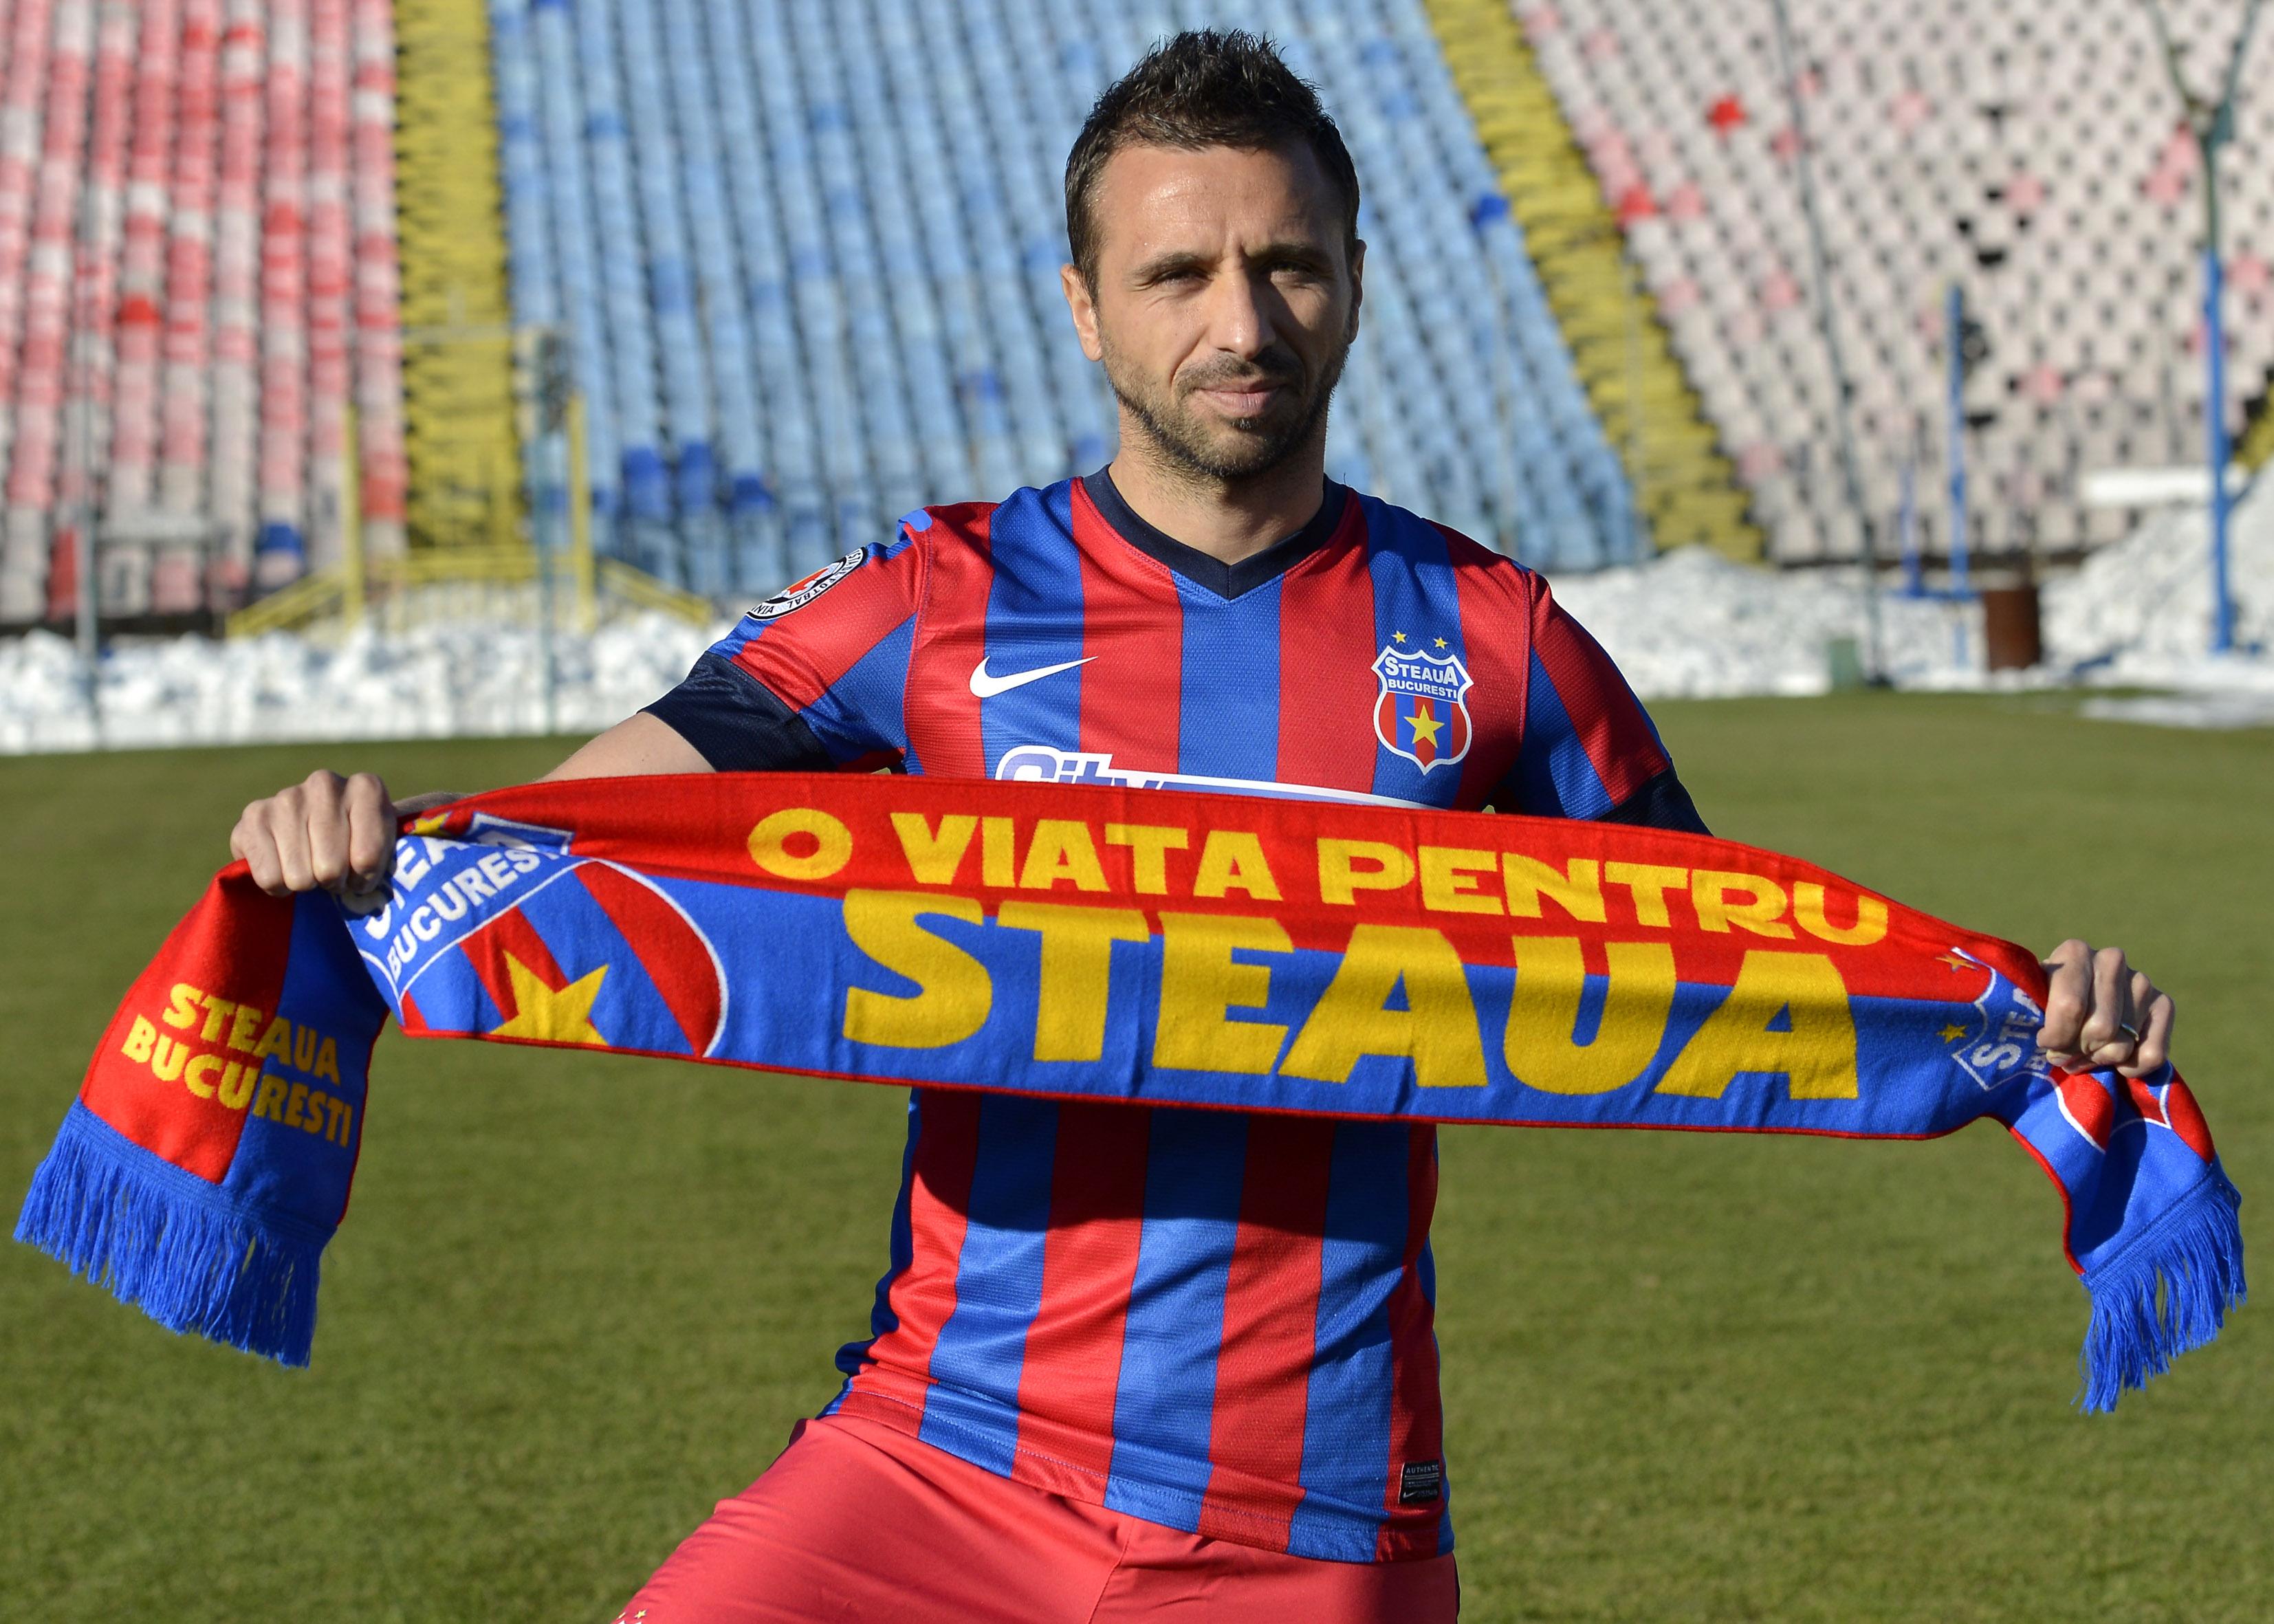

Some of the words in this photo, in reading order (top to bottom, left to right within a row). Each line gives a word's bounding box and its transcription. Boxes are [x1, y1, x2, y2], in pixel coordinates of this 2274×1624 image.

[787, 577, 838, 608] FOTBAL
[1384, 656, 1459, 687] STEAUA
[1388, 679, 1458, 699] BUCURESTI
[747, 807, 853, 880] O
[890, 811, 1283, 901] VIATA
[1316, 837, 1889, 946] PENTRU
[162, 983, 341, 1087] STEAUA
[842, 888, 1859, 1100] STEAUA
[121, 1014, 353, 1148] BUCURESTI
